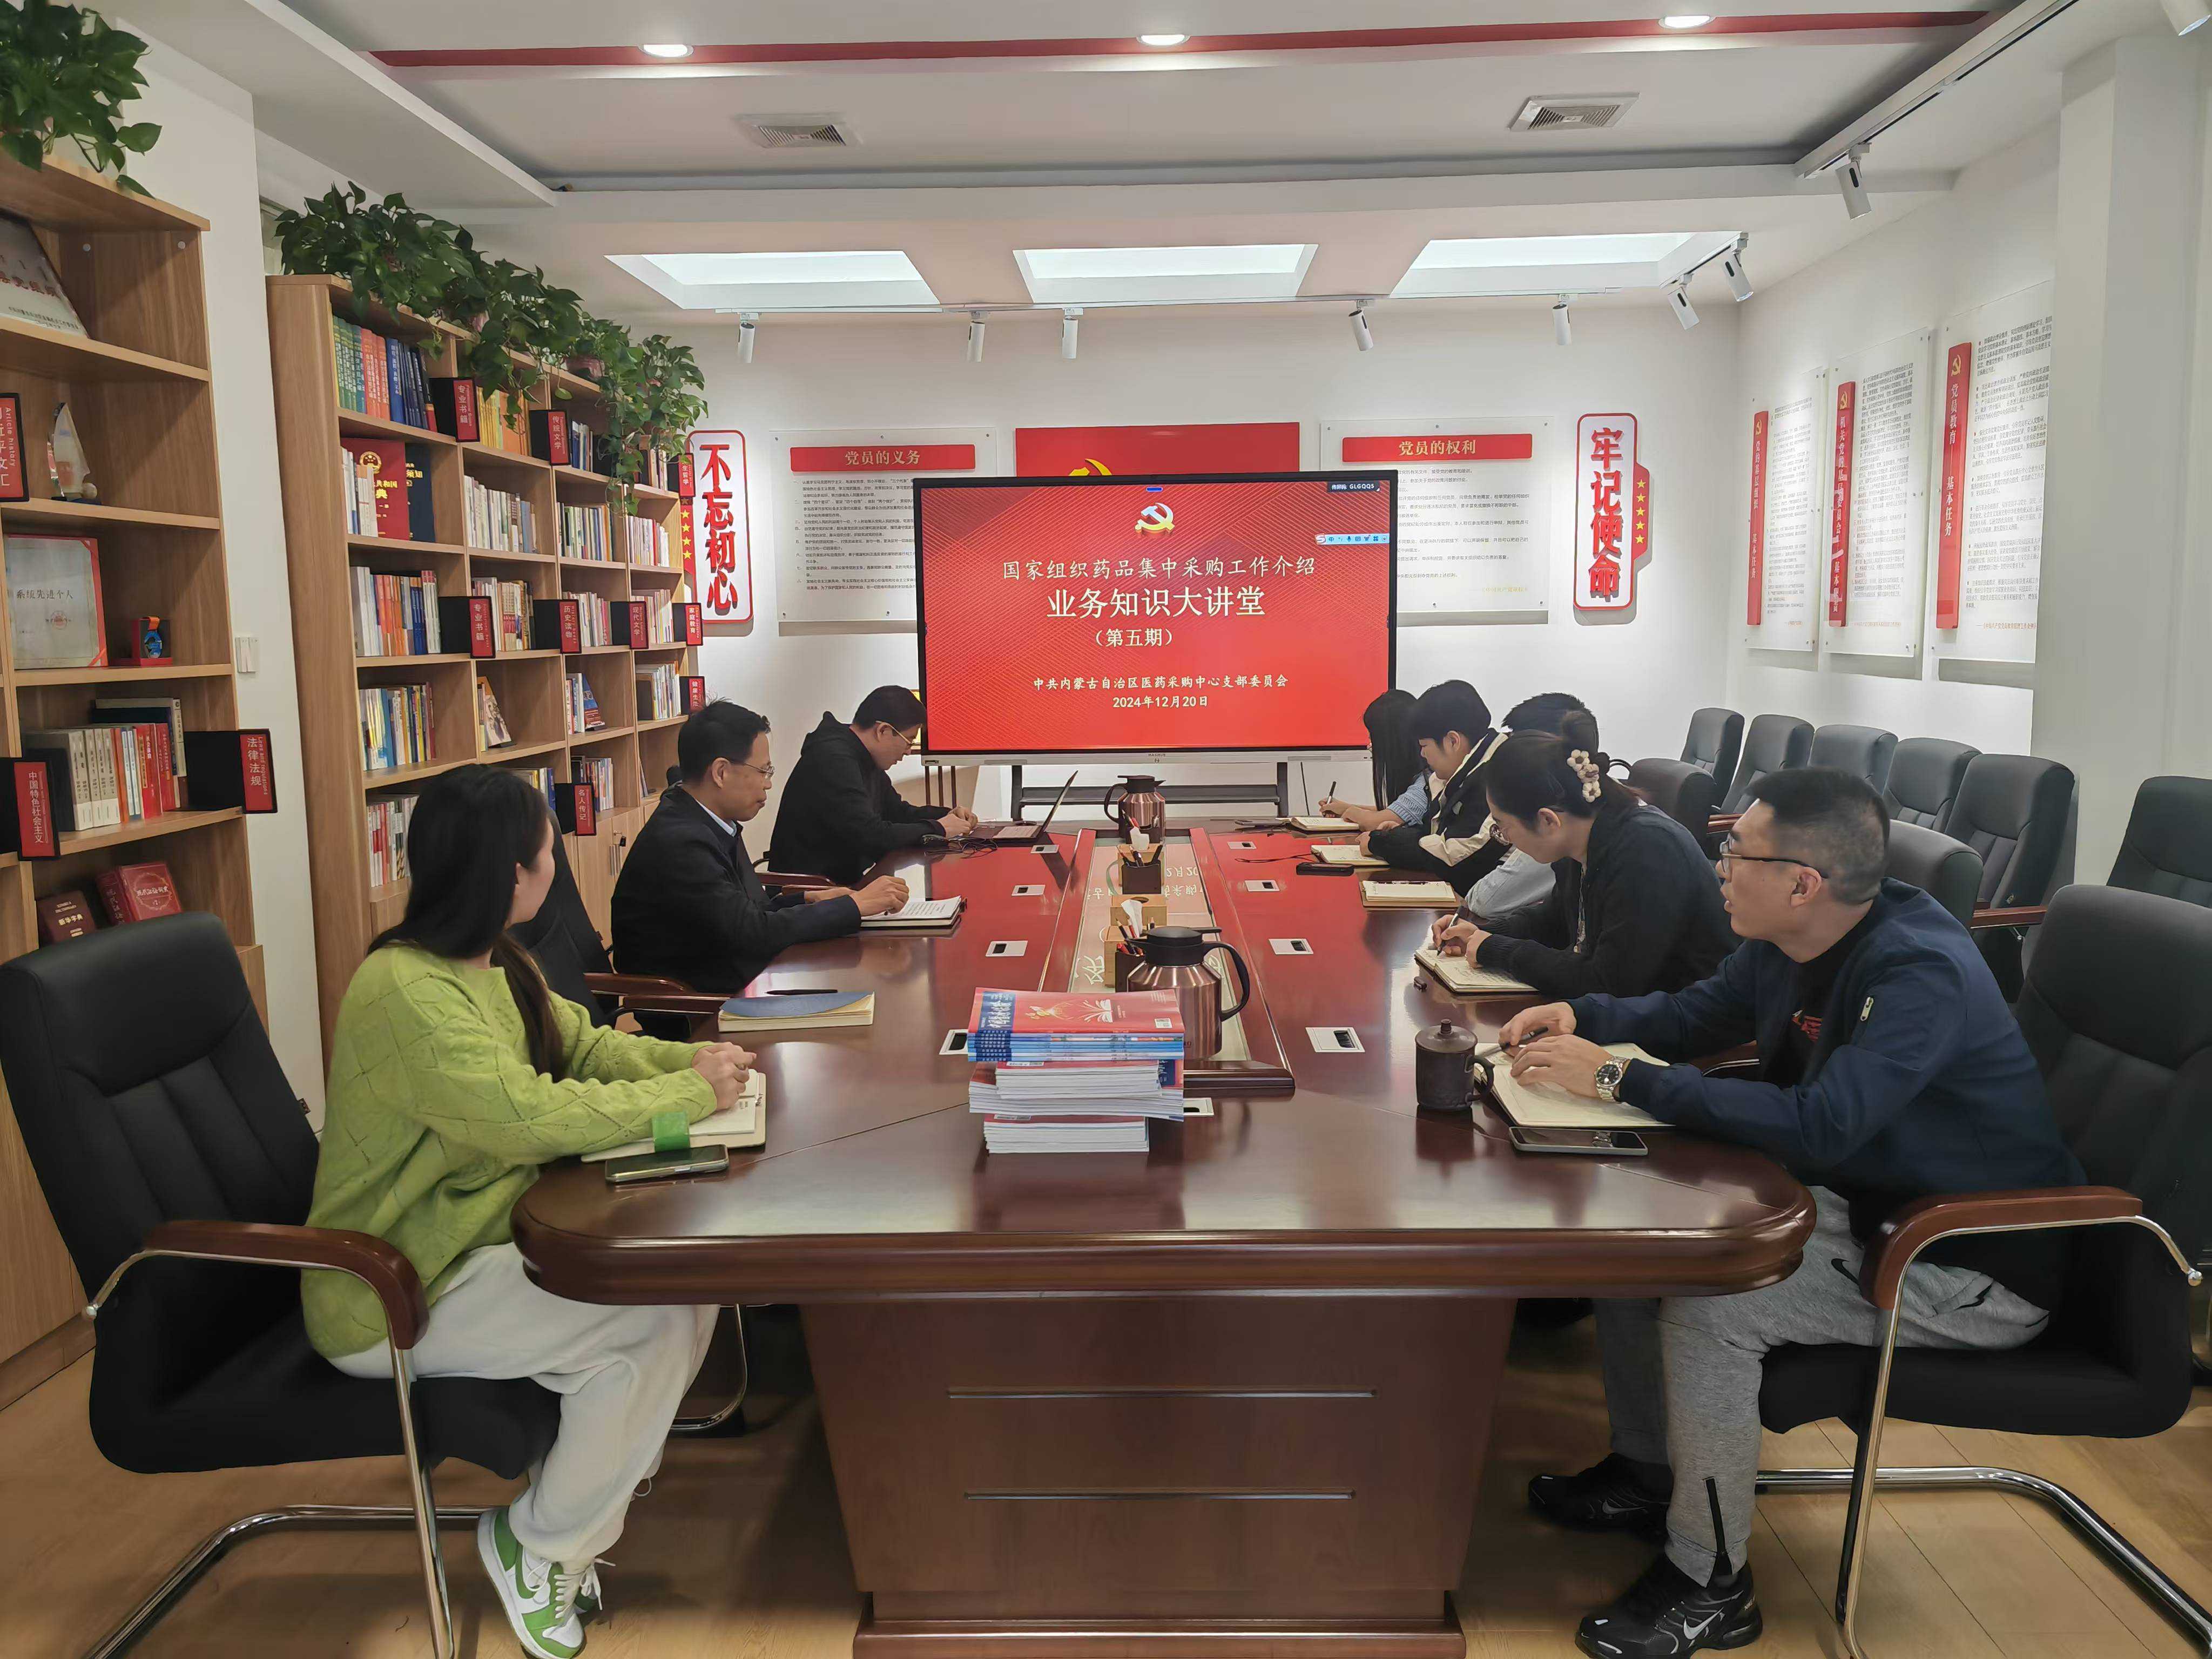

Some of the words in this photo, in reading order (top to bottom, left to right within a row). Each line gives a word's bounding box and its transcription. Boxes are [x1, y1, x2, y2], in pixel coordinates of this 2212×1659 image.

[844, 449, 921, 466] 党员的义务
[1398, 439, 1477, 456] 党员的权利
[1588, 427, 1624, 603] 牢记使命
[699, 444, 738, 616] 不忘初心
[1002, 556, 1316, 581] 国家组织药品集中采购工作介绍
[1047, 585, 1265, 619] 业务知识大讲堂
[1095, 628, 1175, 647] （第五期）
[1033, 675, 1288, 691] 中共内蒙古自治区医药采购中心支部委员会
[1112, 695, 1208, 709] 2024年12月20日
[578, 789, 586, 820] 名人传记
